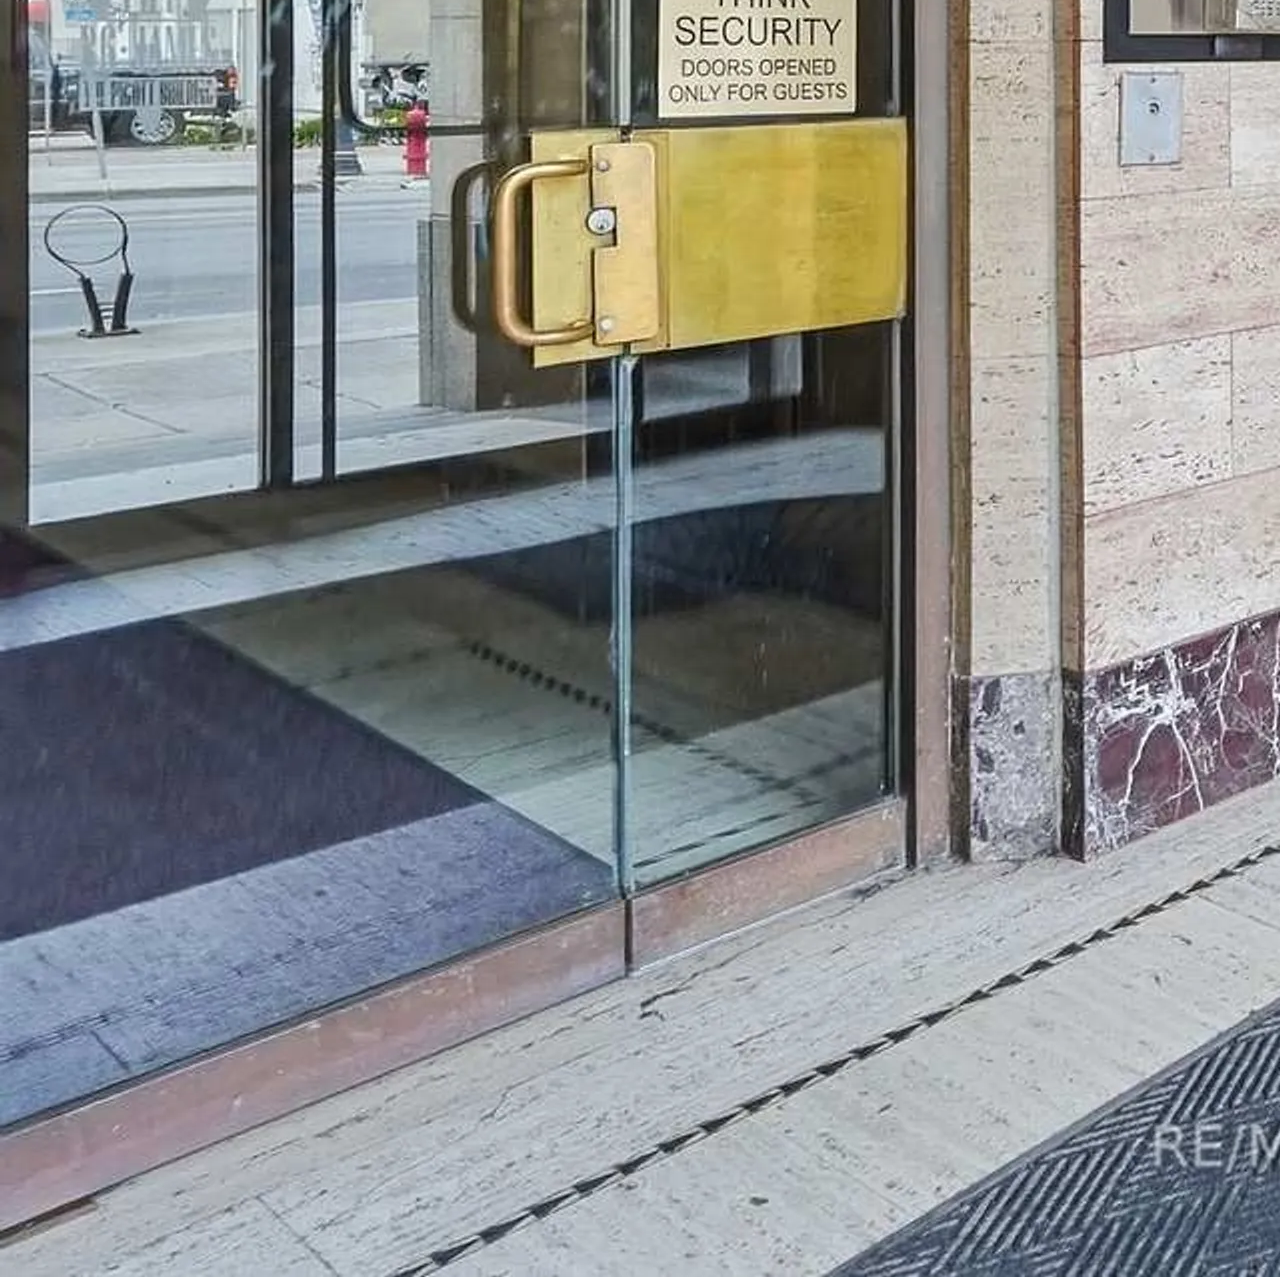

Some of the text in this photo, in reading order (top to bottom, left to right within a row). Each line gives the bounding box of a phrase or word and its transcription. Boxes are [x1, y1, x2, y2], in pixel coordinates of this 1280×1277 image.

[674, 15, 842, 47] SECURITY
[681, 58, 837, 78] DOORS OPENED
[668, 81, 848, 103] ONLY FOR GUESTS
